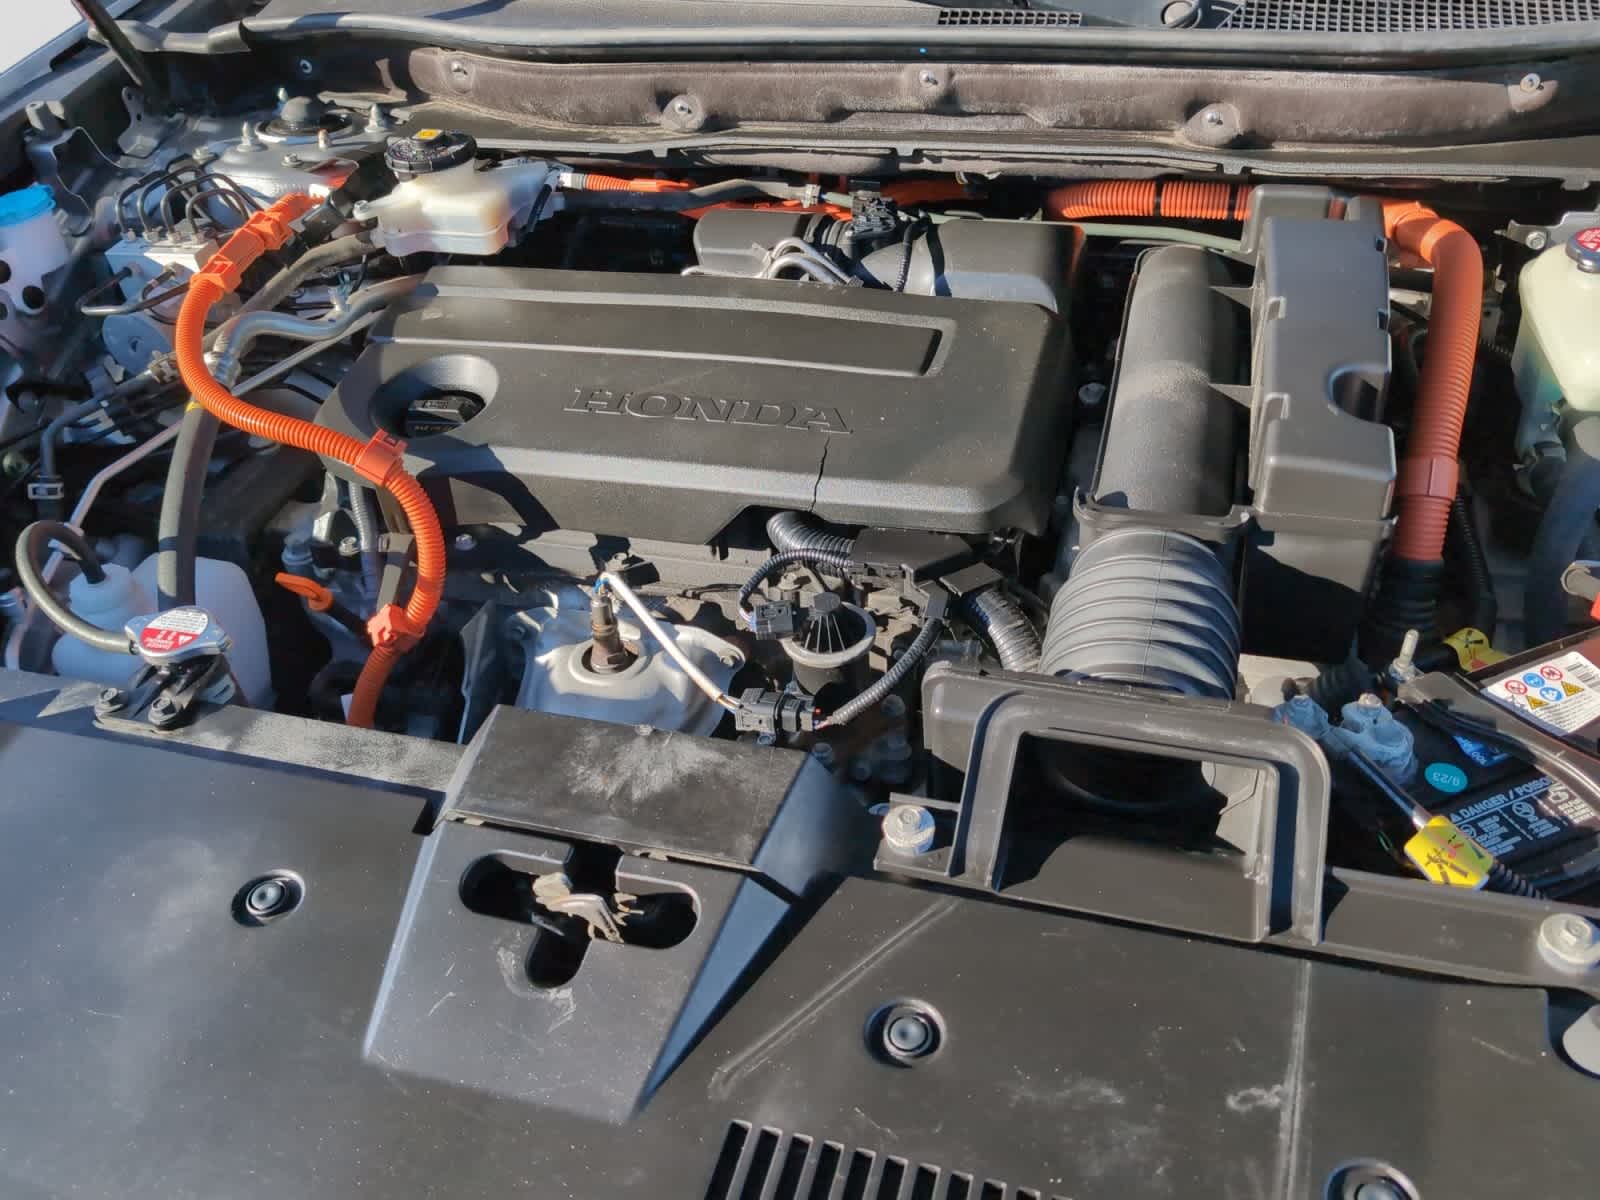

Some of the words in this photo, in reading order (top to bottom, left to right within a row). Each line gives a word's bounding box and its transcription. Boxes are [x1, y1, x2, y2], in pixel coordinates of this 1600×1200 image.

[563, 386, 854, 434] HONDA
[1459, 793, 1509, 818] DANGER
[1514, 776, 1553, 796] POISO
